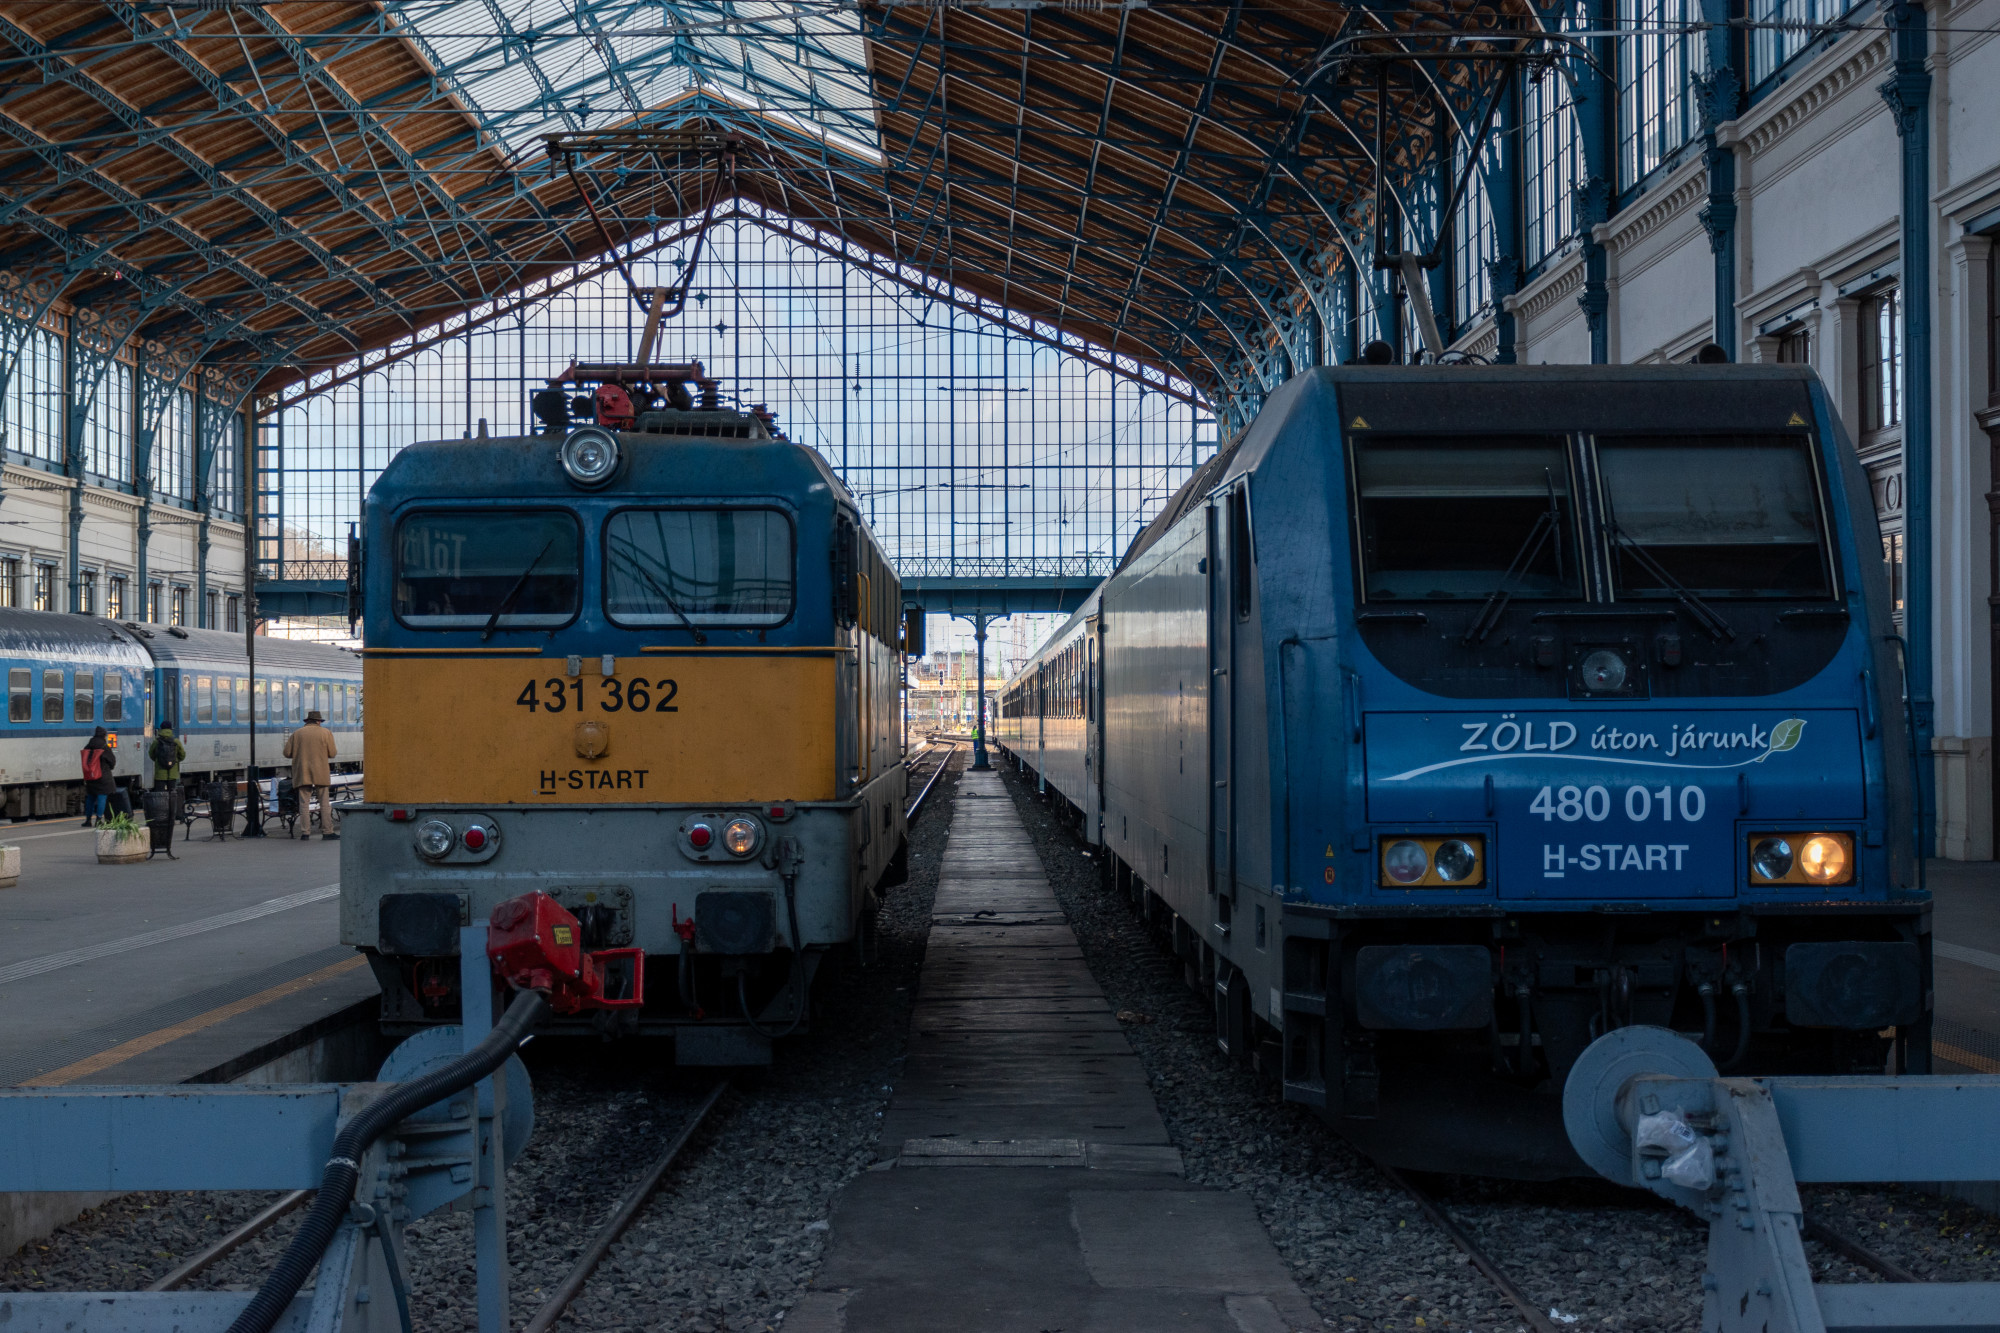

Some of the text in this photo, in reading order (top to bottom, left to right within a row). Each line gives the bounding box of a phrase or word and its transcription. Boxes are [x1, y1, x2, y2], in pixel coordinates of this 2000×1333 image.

[516, 677, 679, 713] 431 362
[1460, 713, 1768, 757] ZÖLD úton járunk
[540, 769, 649, 795] H-START
[1529, 785, 1706, 822] 480 010
[1543, 844, 1689, 878] H-START
